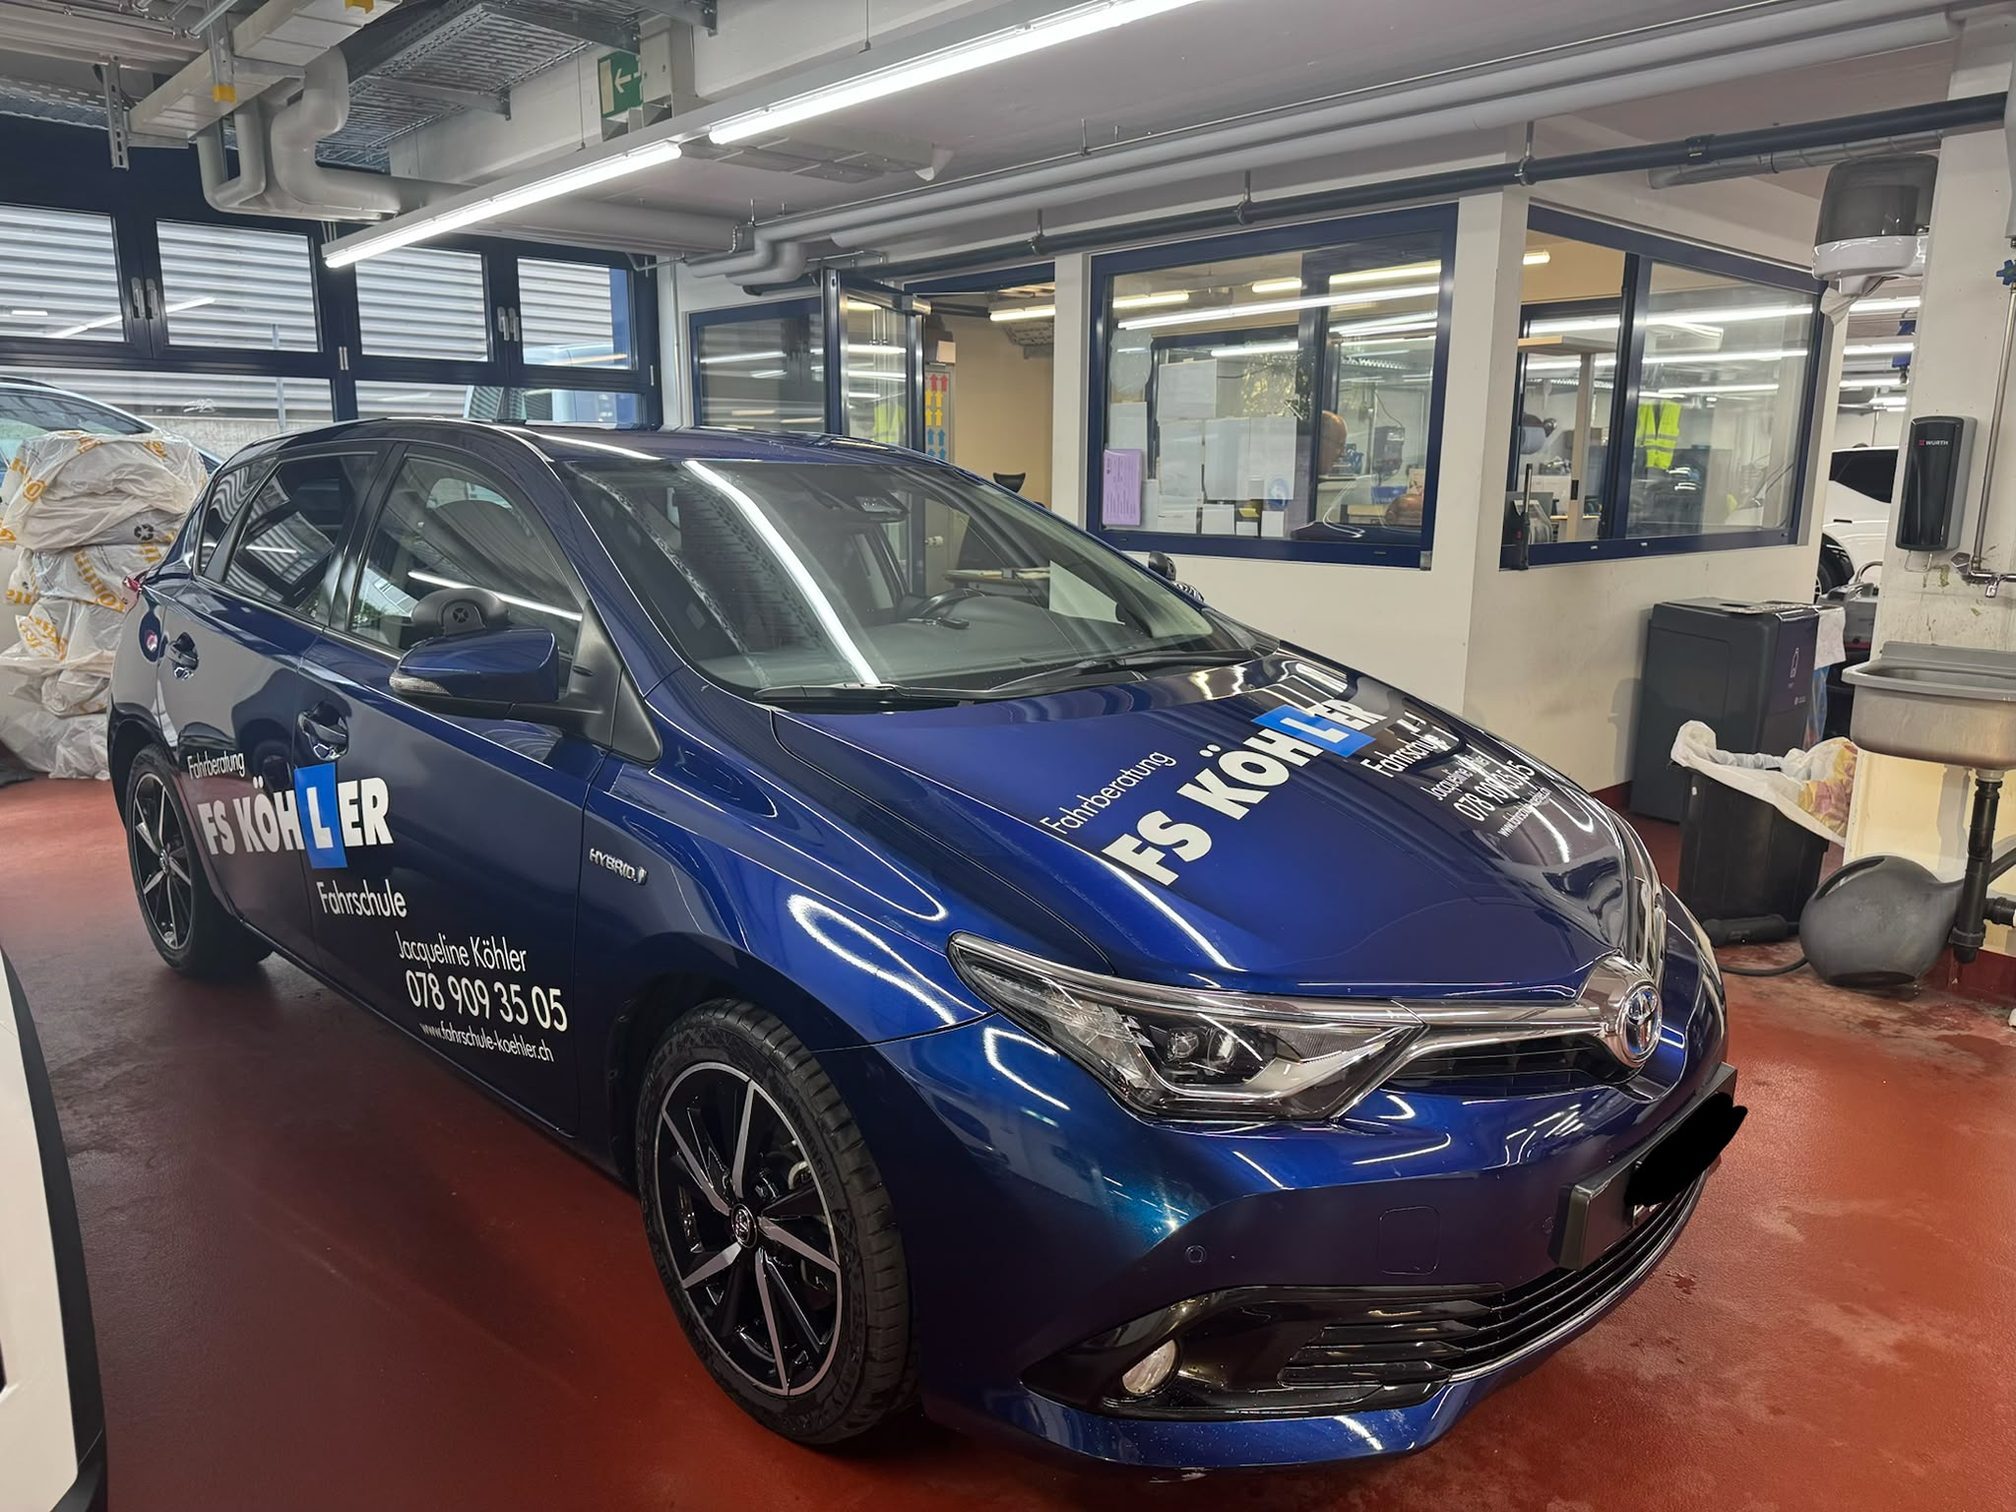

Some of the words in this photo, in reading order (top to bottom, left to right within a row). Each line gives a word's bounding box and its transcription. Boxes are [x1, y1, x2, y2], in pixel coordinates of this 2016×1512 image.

[187, 751, 246, 778] Fahrberatung
[1040, 751, 1177, 835] Fahrberatung
[1101, 810, 1212, 886] FS
[1176, 699, 1387, 820] KÖHLER
[1453, 793, 1495, 822] 078
[198, 800, 235, 855] FS
[233, 776, 393, 853] KÖHLER
[589, 848, 636, 880] HYBRID
[316, 879, 407, 917] Fahrschule
[395, 931, 470, 969] Jacqueline
[470, 936, 527, 972] Köhler
[406, 969, 446, 1011] 078
[447, 975, 490, 1020] 909
[494, 982, 529, 1025] 35
[531, 985, 568, 1032] 05
[419, 1020, 555, 1062] www.fahrschule-koehler.ch
